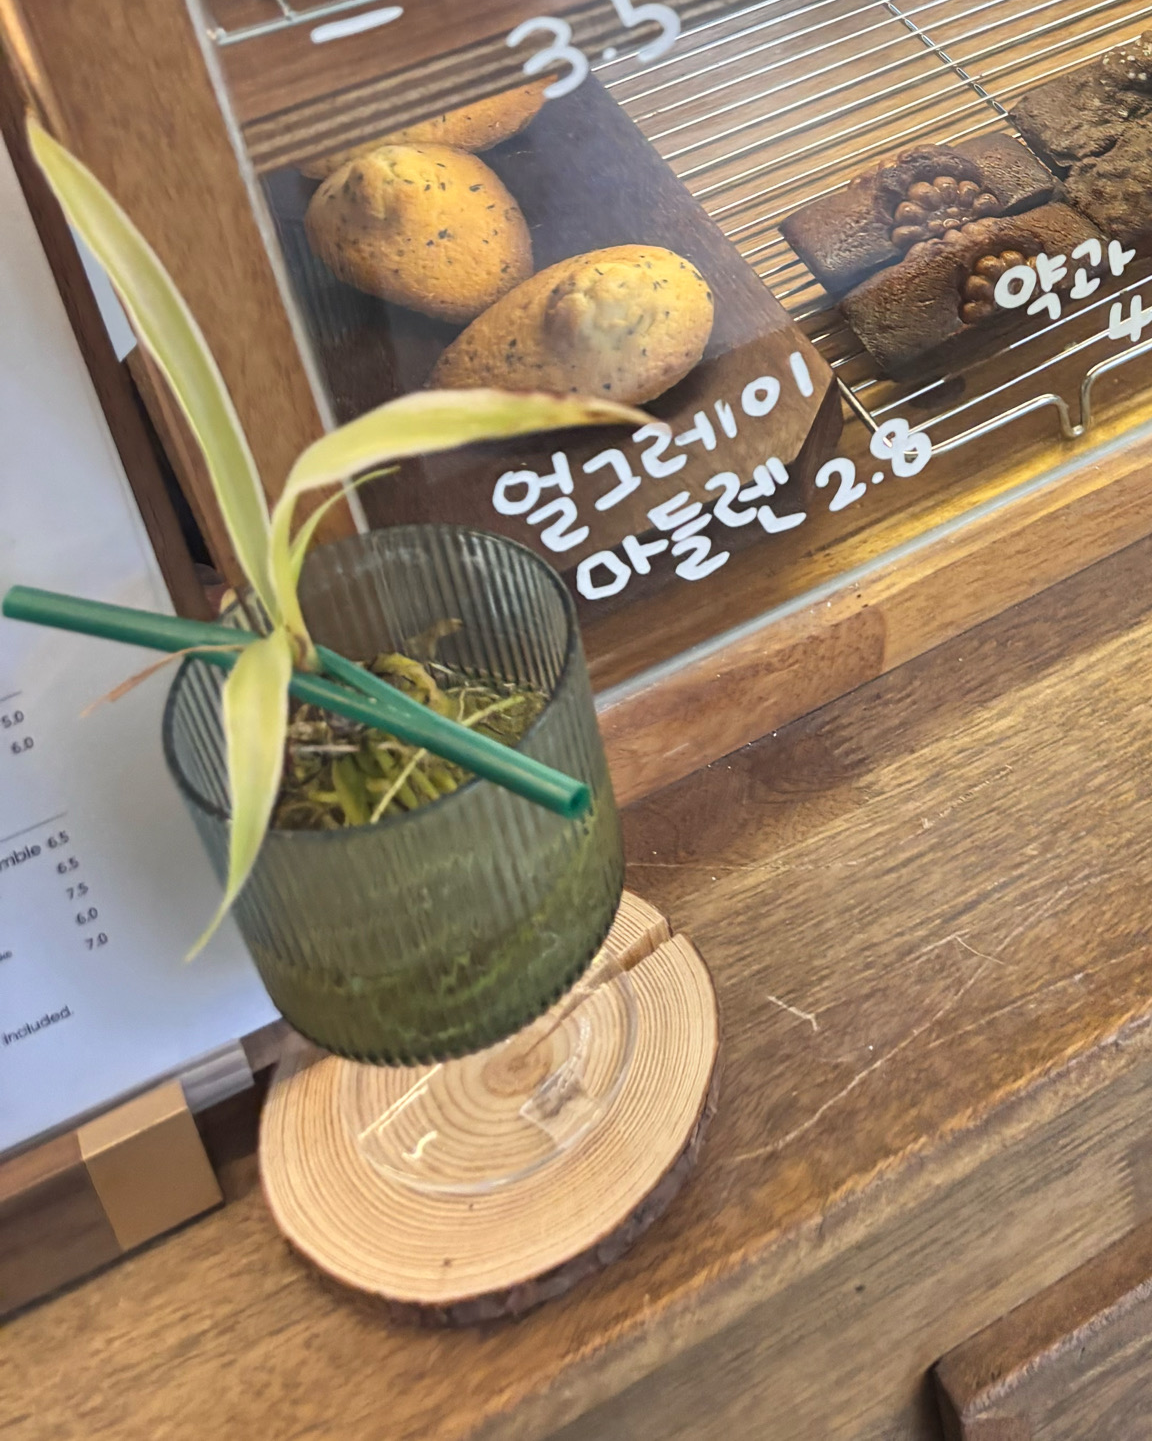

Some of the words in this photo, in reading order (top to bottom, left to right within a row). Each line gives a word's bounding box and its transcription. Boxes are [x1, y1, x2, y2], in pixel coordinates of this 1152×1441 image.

[993, 237, 1137, 320] 약과
[492, 351, 815, 553] 얼그레이
[575, 456, 807, 601] 마들렌
[815, 417, 933, 513] 2.8
[1, 710, 25, 729] 5.0
[11, 736, 35, 755] 6.0
[47, 830, 70, 849] 6.5
[57, 856, 79, 874] 6.5
[66, 882, 89, 900] 7.5
[75, 907, 99, 926] 6.0
[85, 932, 108, 951] 7.0
